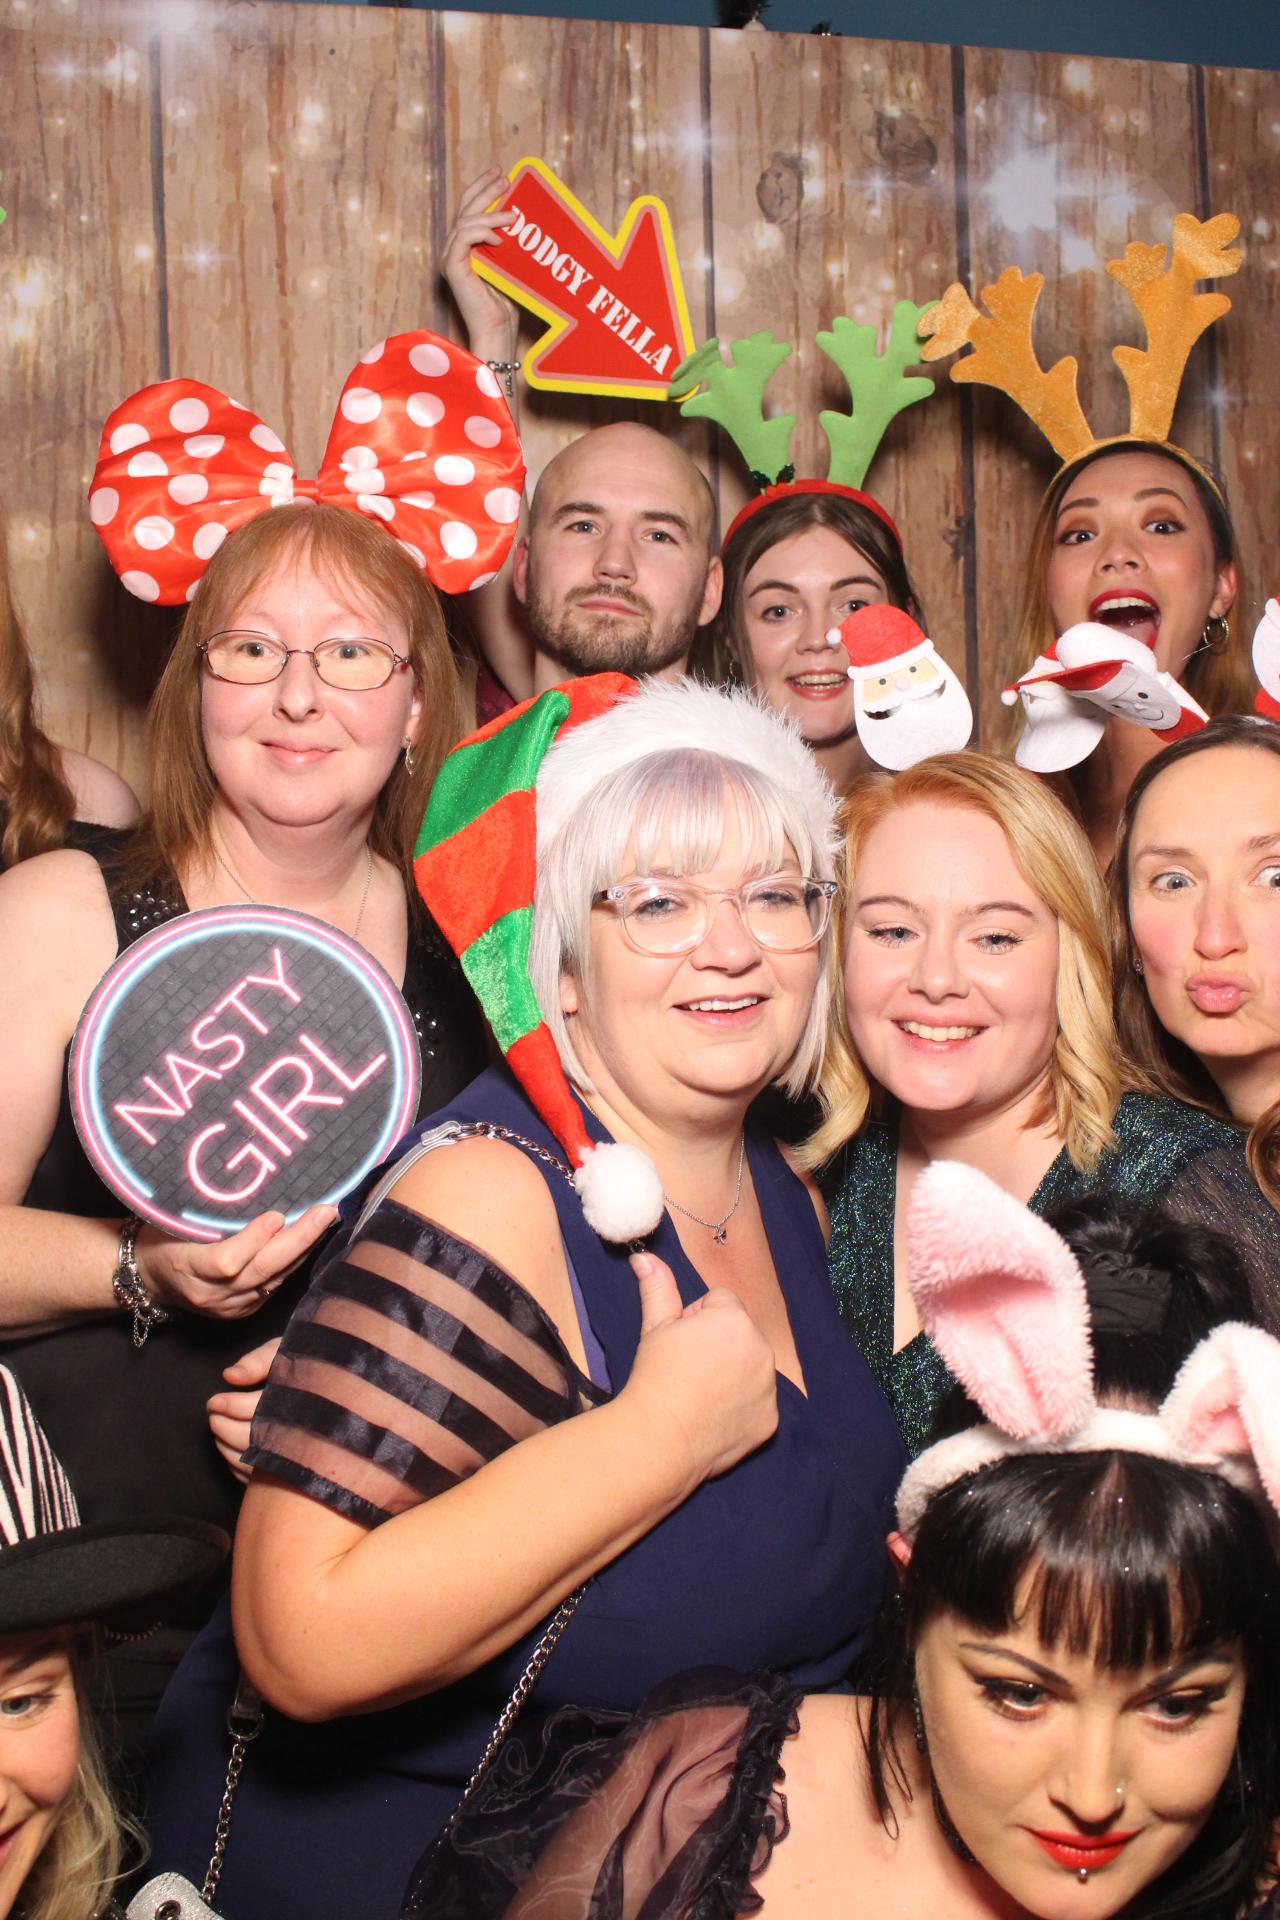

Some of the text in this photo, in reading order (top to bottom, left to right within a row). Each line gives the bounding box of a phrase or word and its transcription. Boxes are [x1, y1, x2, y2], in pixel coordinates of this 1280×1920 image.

[502, 205, 673, 375] DODGY FELLA
[114, 947, 301, 1146] NASTY
[187, 1033, 387, 1202] GIRL
